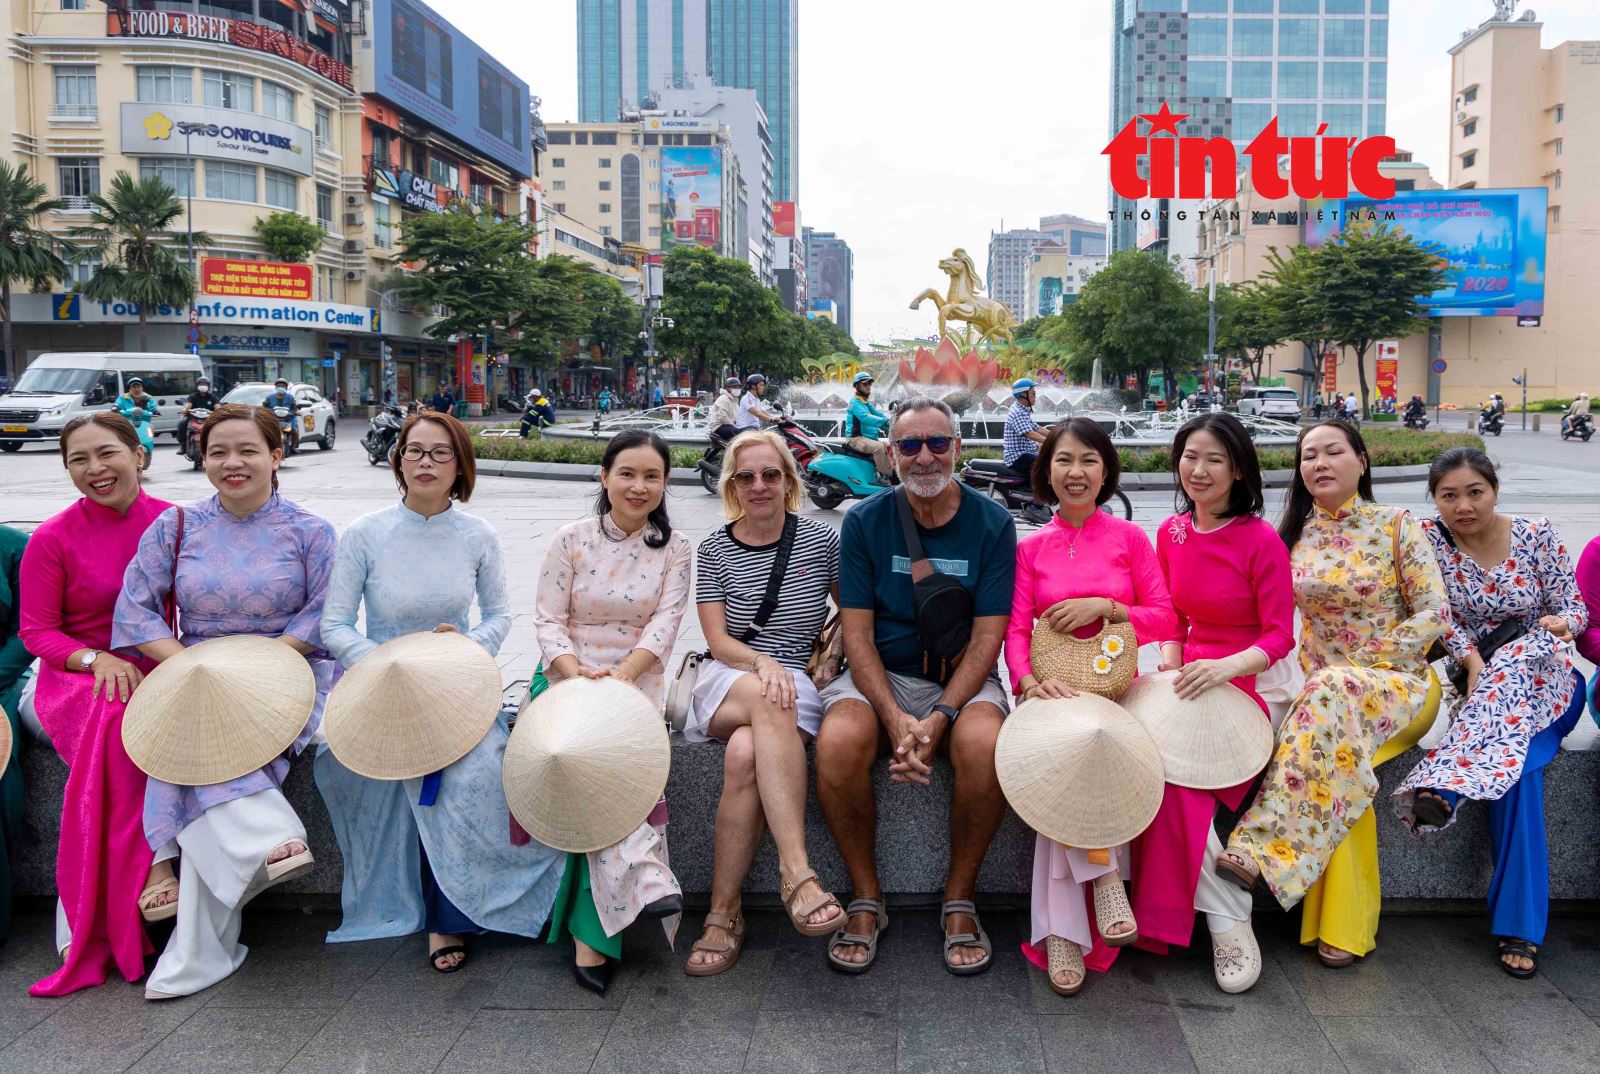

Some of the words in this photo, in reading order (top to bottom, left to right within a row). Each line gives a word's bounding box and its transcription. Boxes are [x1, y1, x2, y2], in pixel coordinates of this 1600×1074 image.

[129, 11, 169, 35] FOOD
[173, 16, 183, 34] &
[186, 13, 229, 42] BEER
[235, 20, 298, 59] SKY
[303, 42, 353, 88] ZONE
[1462, 276, 1508, 292] 2026
[98, 299, 183, 316] Touist
[192, 301, 319, 323] nformation
[325, 308, 365, 326] Center
[210, 335, 290, 347] SAIGONTOURIST
